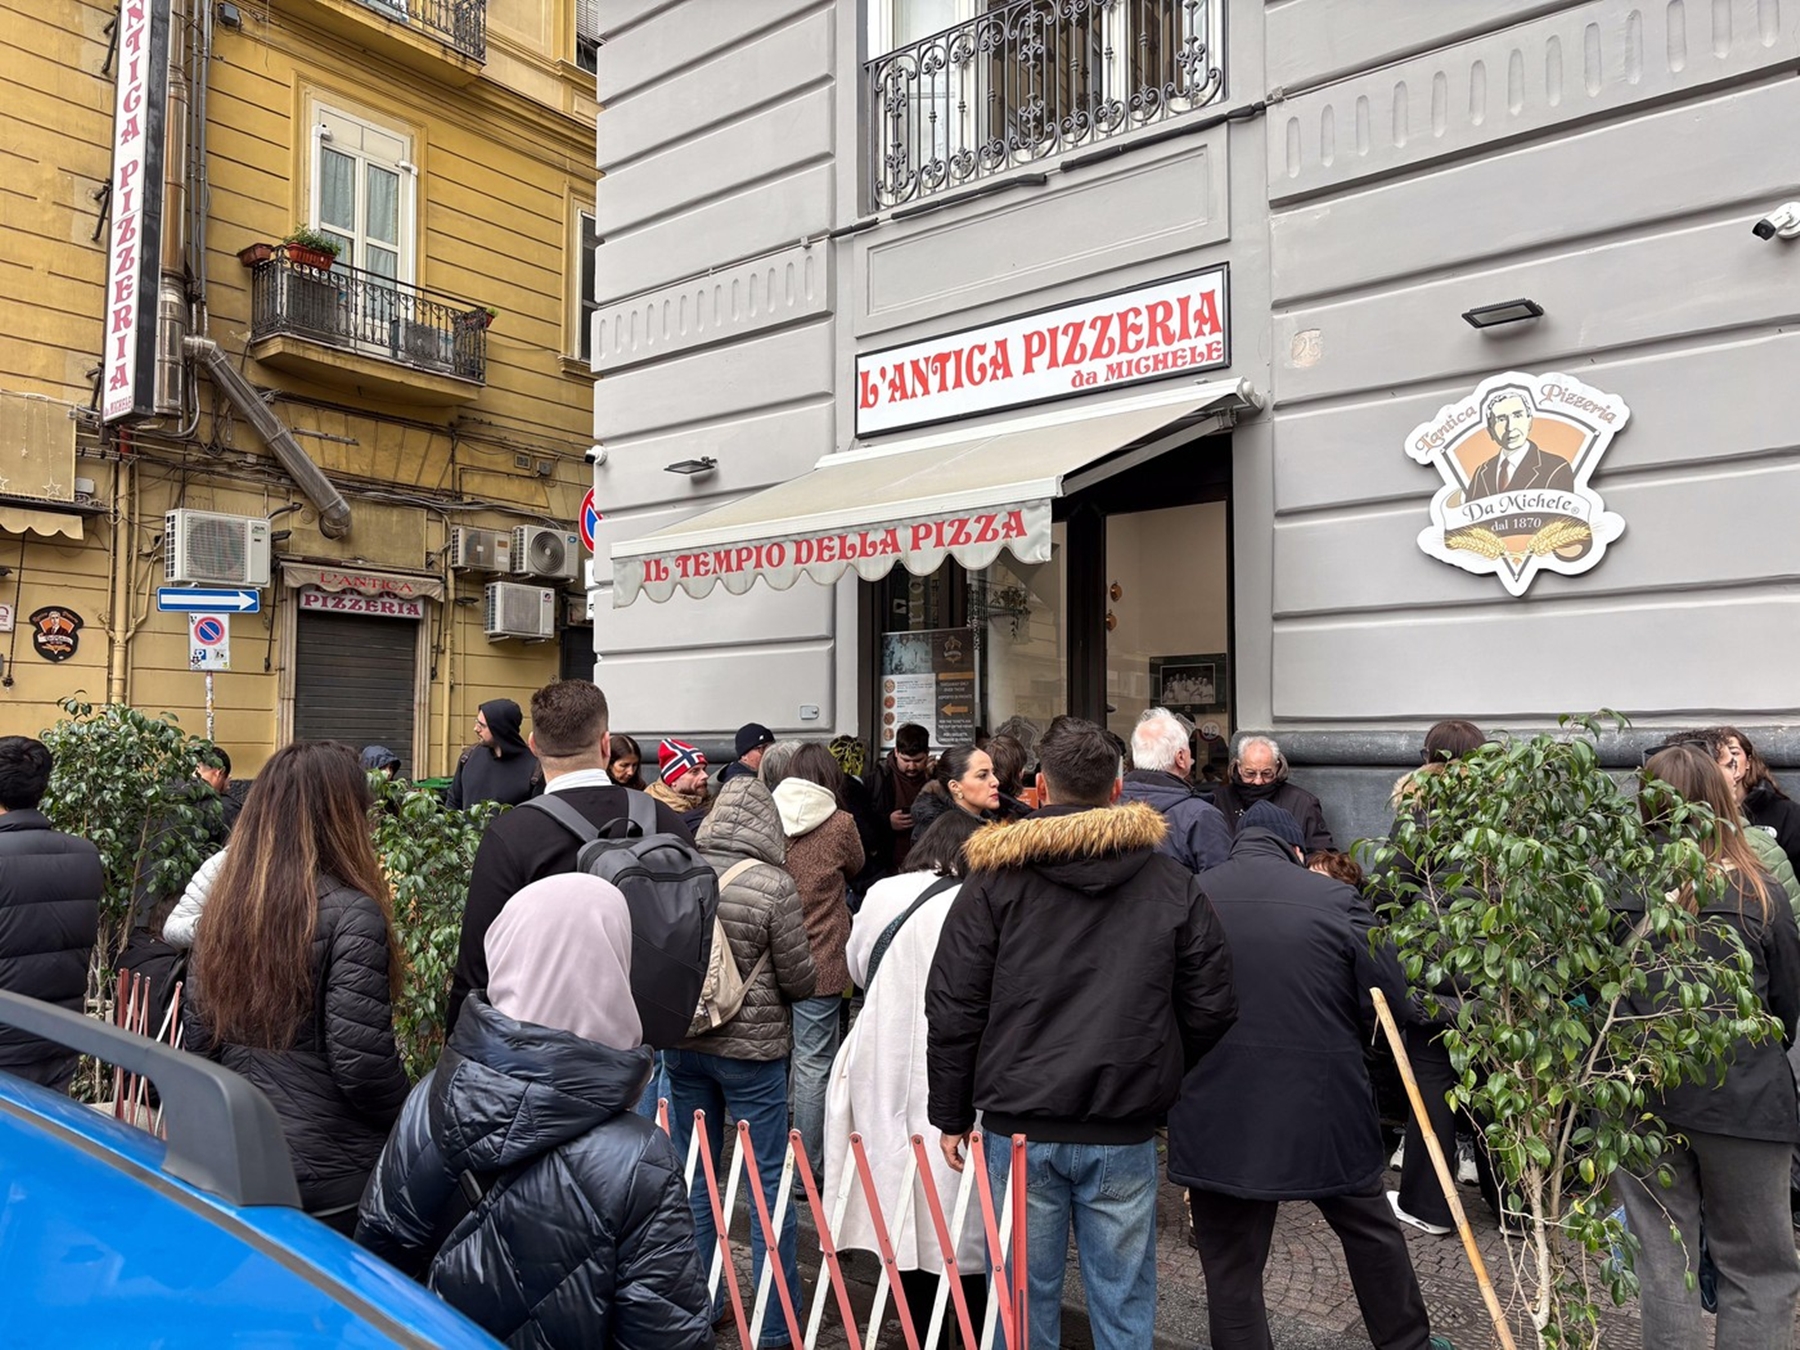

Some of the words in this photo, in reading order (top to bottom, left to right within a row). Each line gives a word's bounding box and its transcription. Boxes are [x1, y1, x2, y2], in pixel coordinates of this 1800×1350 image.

[121, 0, 145, 146] NTICA
[110, 159, 139, 392] PIZZERIA
[860, 337, 1013, 409] L'ANTICA
[1022, 289, 1222, 375] PIZZERIA
[1071, 370, 1098, 389] da
[1104, 341, 1222, 382] MICHELE
[1539, 384, 1617, 424] Pizzeria
[1462, 503, 1494, 522] Da
[1500, 493, 1572, 514] Michele
[1491, 519, 1508, 531] dal
[1513, 517, 1542, 529] 1870
[643, 558, 669, 582] IL
[675, 542, 786, 578] TEMPIO
[794, 527, 902, 565] DELLA
[910, 510, 1028, 551] PIZZA
[304, 593, 421, 616] PIZZERIA
[320, 573, 413, 593] L'ANTICA
